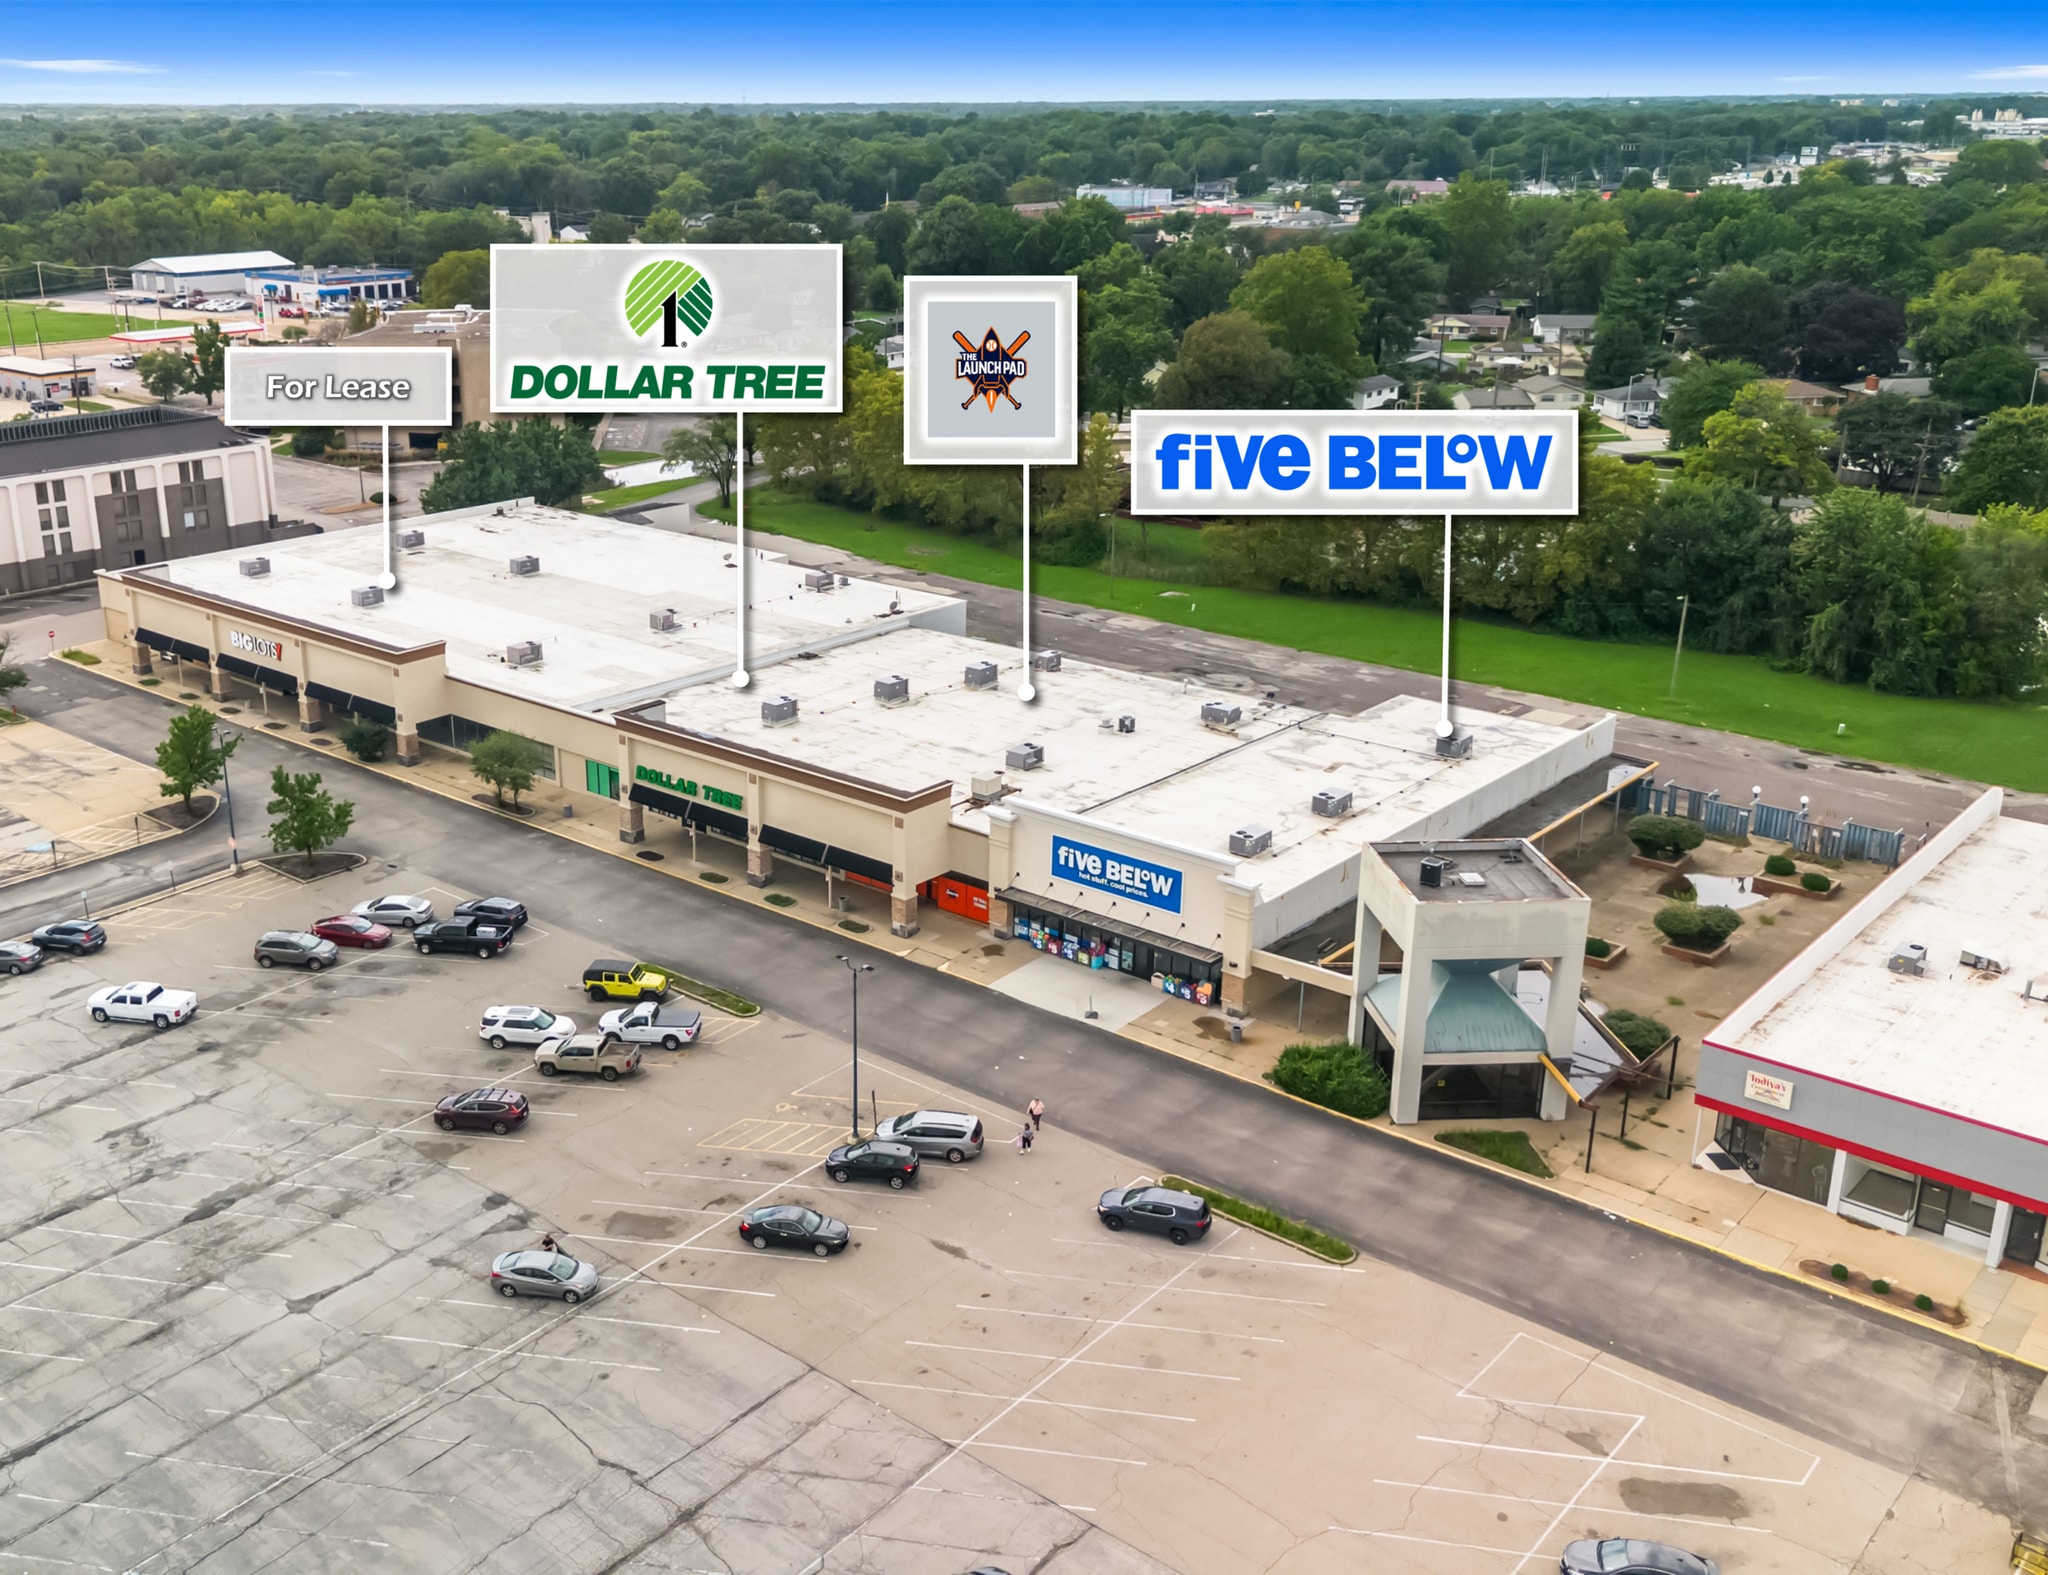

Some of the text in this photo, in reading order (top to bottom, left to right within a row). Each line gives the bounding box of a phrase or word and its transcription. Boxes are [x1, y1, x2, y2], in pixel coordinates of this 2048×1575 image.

[230, 630, 254, 652] BIG
[636, 765, 743, 810] DOLLAR TREE
[1058, 845, 1174, 897] five BELOW
